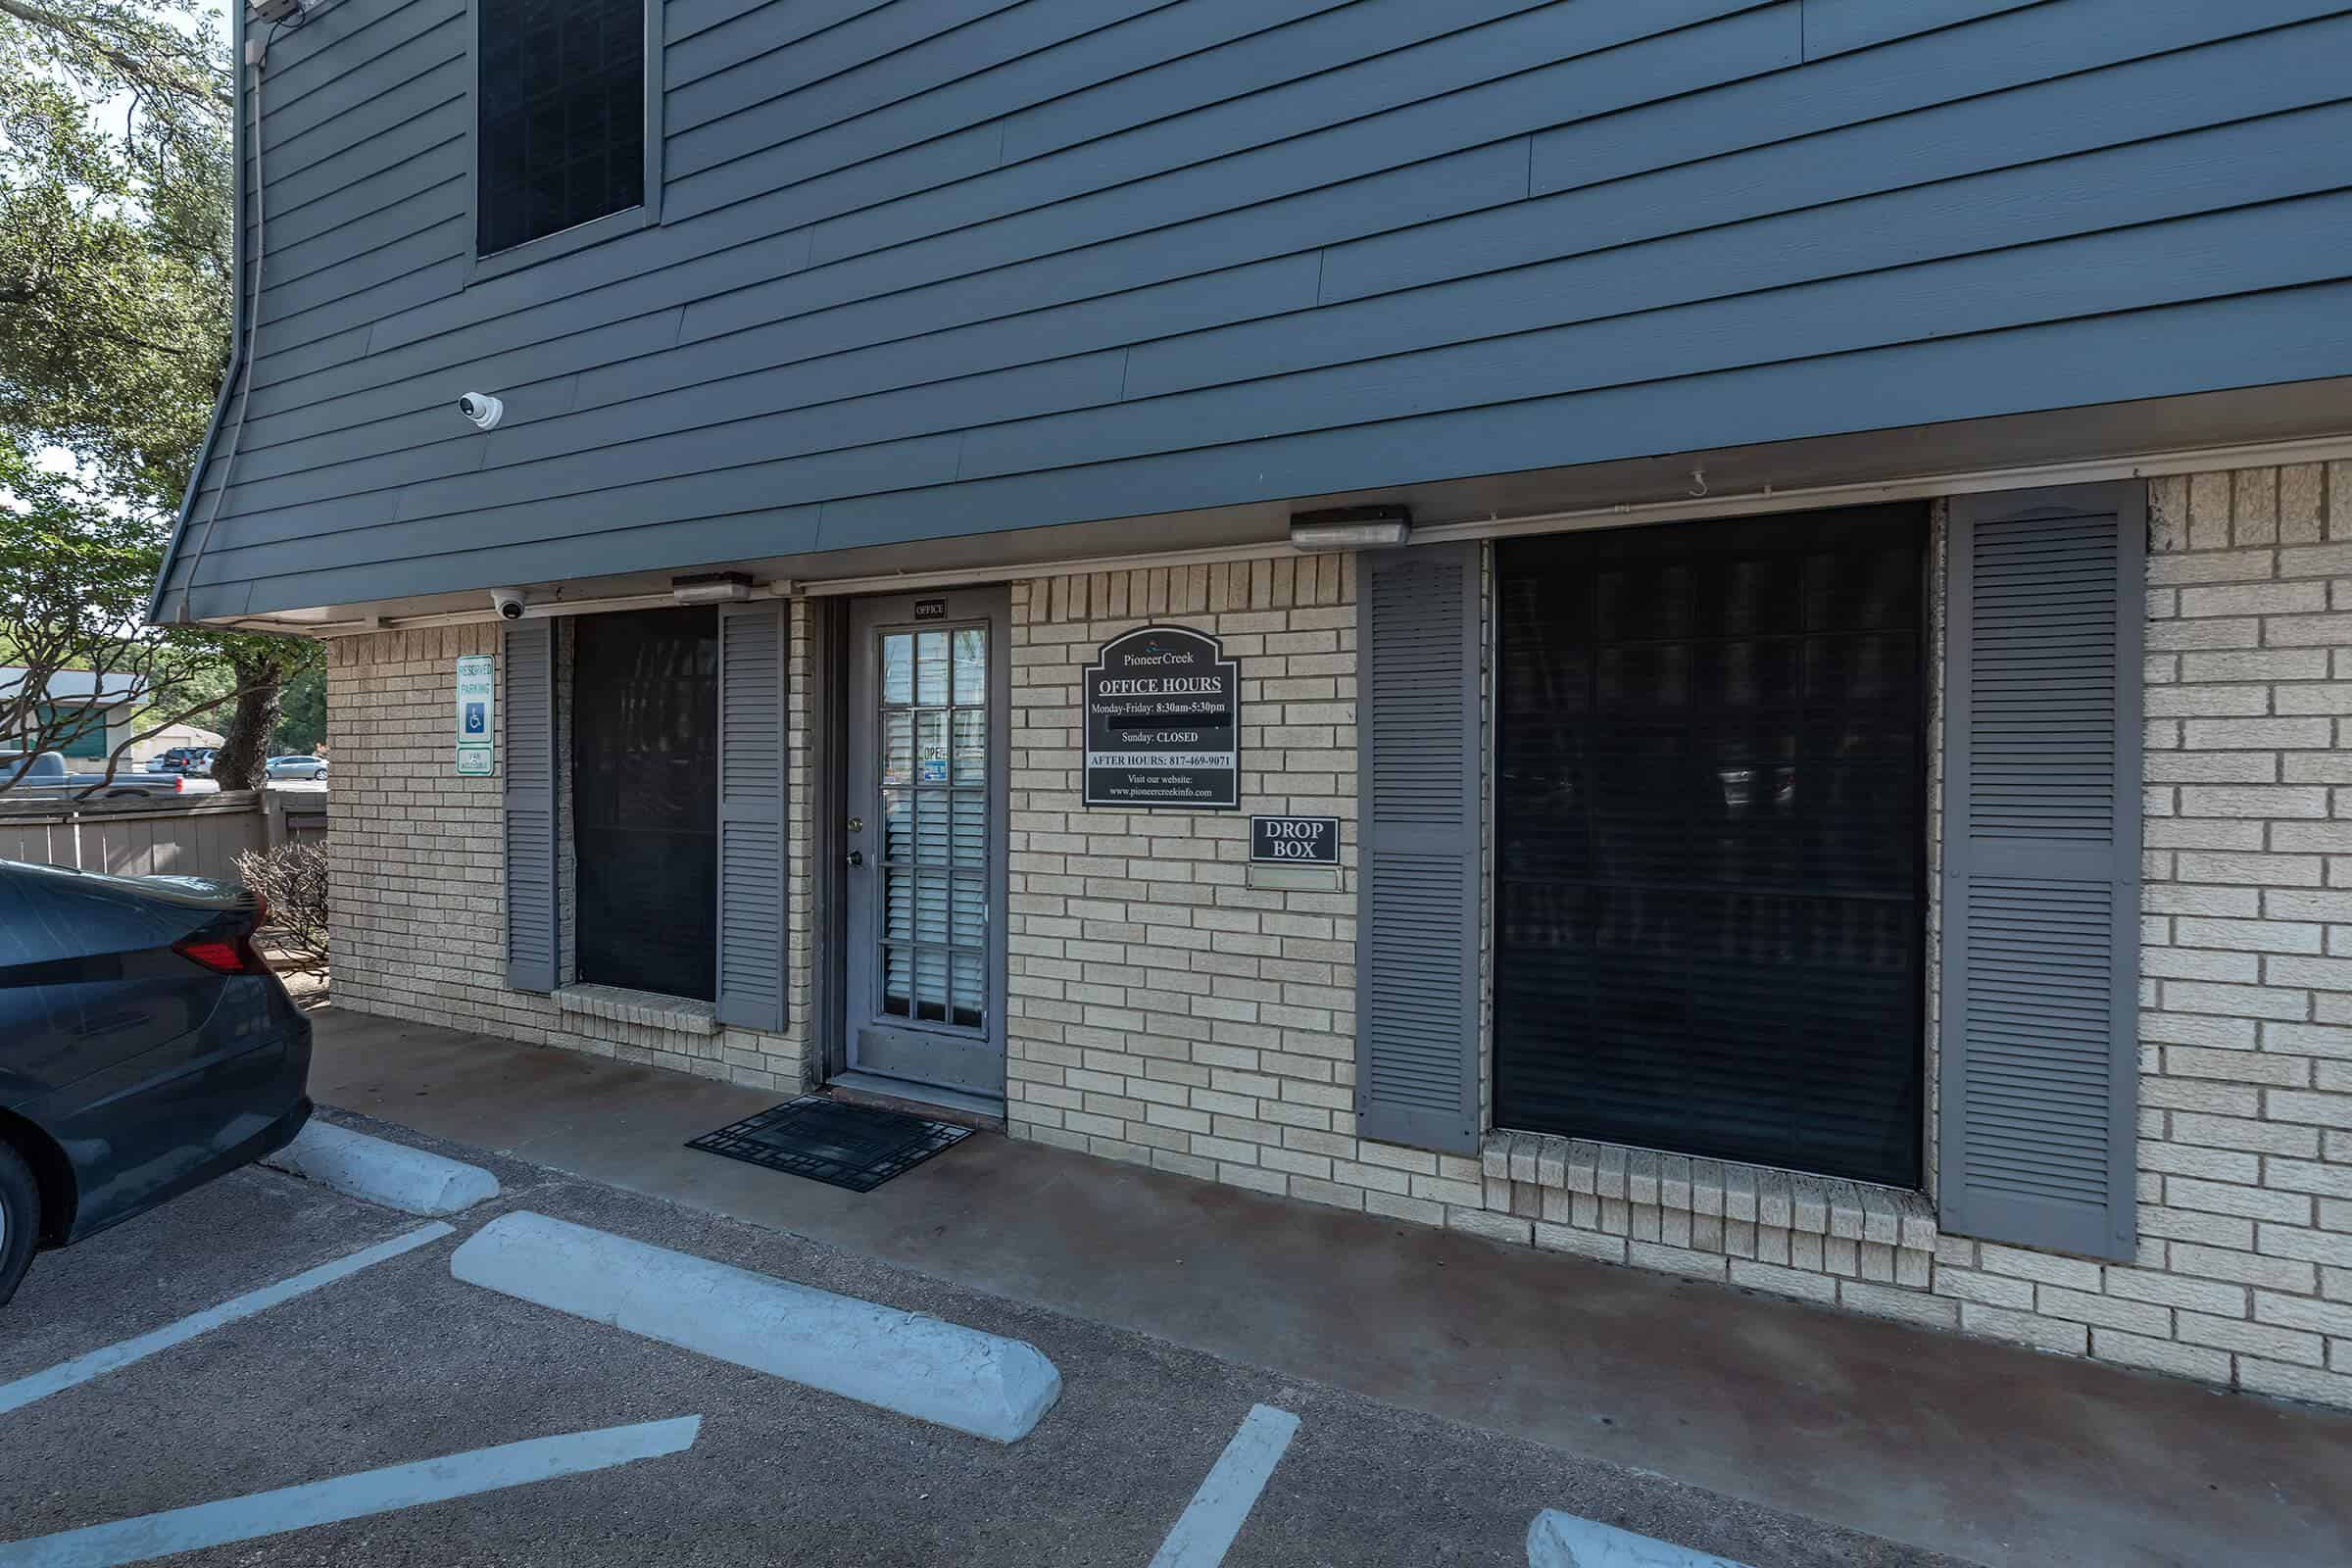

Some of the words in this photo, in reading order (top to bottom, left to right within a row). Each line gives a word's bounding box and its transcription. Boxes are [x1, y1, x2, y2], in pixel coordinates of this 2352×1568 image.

[916, 604, 943, 614] OFFICE
[1099, 679, 1158, 694] OFFICE
[1163, 676, 1222, 692] HOURS
[1091, 702, 1154, 715] Monday-Friday:
[1156, 701, 1226, 714] 8:30am-5:30pm
[1121, 731, 1154, 745] Sunday:
[1156, 731, 1199, 743] CLOSED
[1091, 756, 1125, 766] AFTER
[1127, 756, 1167, 766] HOURS:
[1168, 755, 1230, 766] 817-469-9071
[1128, 774, 1146, 784] Visit
[1146, 775, 1160, 784] our
[1160, 774, 1193, 784] website:
[1109, 786, 1213, 798] www.pioneercreekinfo.com
[1265, 821, 1324, 840] DROP
[1272, 840, 1317, 858] BOX
